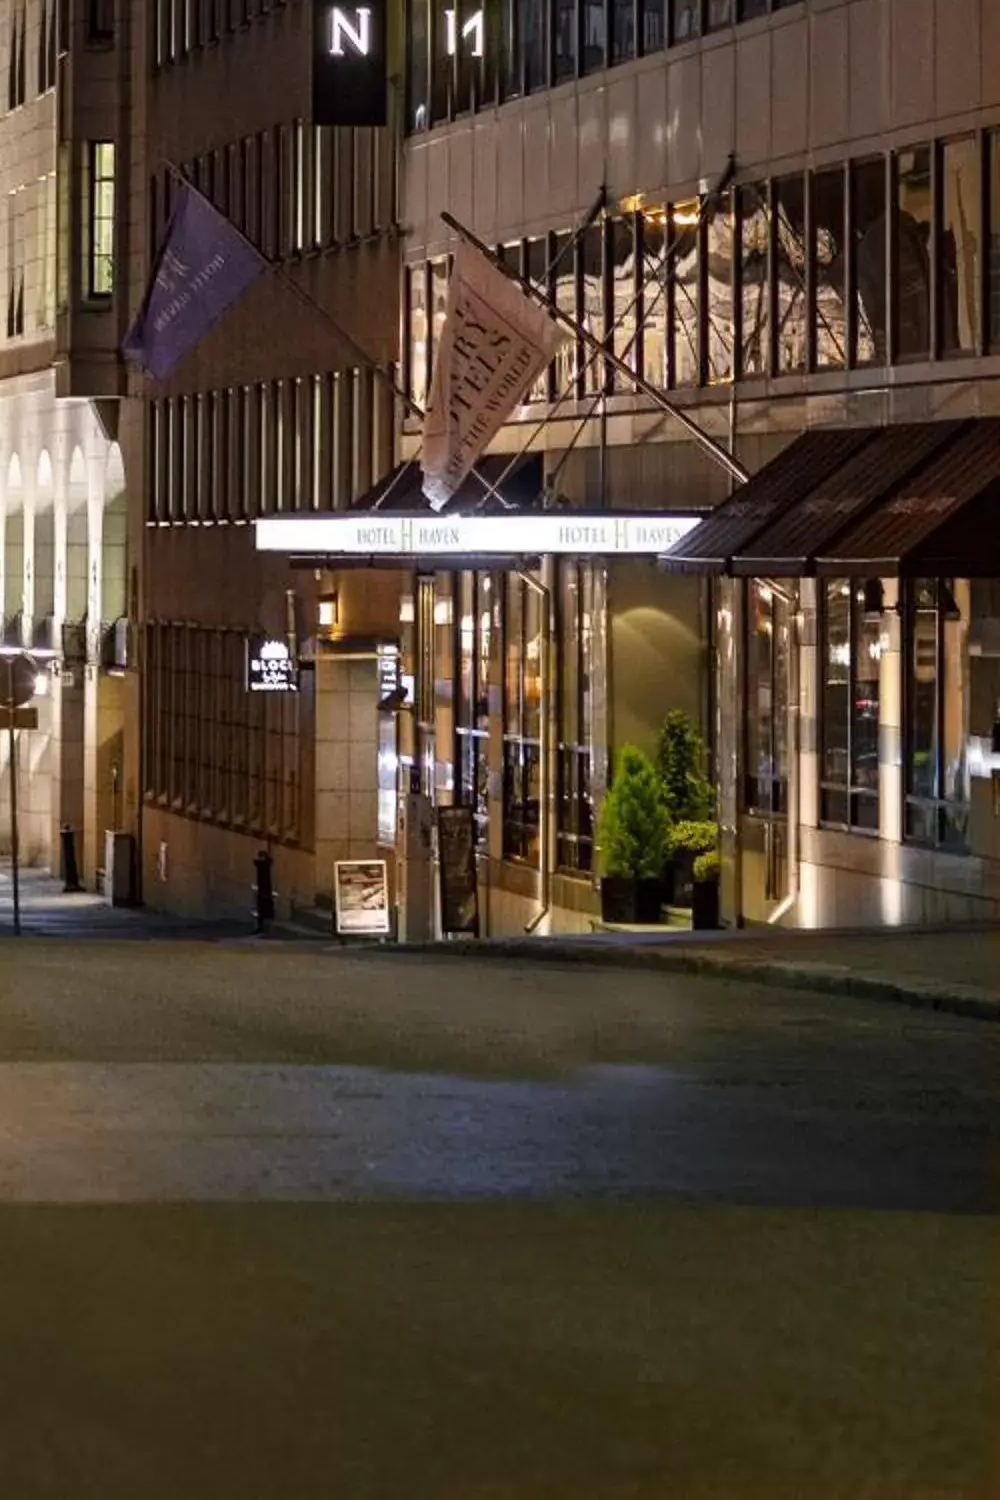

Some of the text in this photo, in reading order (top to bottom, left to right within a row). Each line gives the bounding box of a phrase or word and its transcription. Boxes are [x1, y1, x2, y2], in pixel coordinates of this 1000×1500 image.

[464, 409, 491, 451] THE
[356, 527, 395, 545] HOTEL
[419, 527, 460, 545] HAVEN
[559, 526, 607, 544] HOTEL
